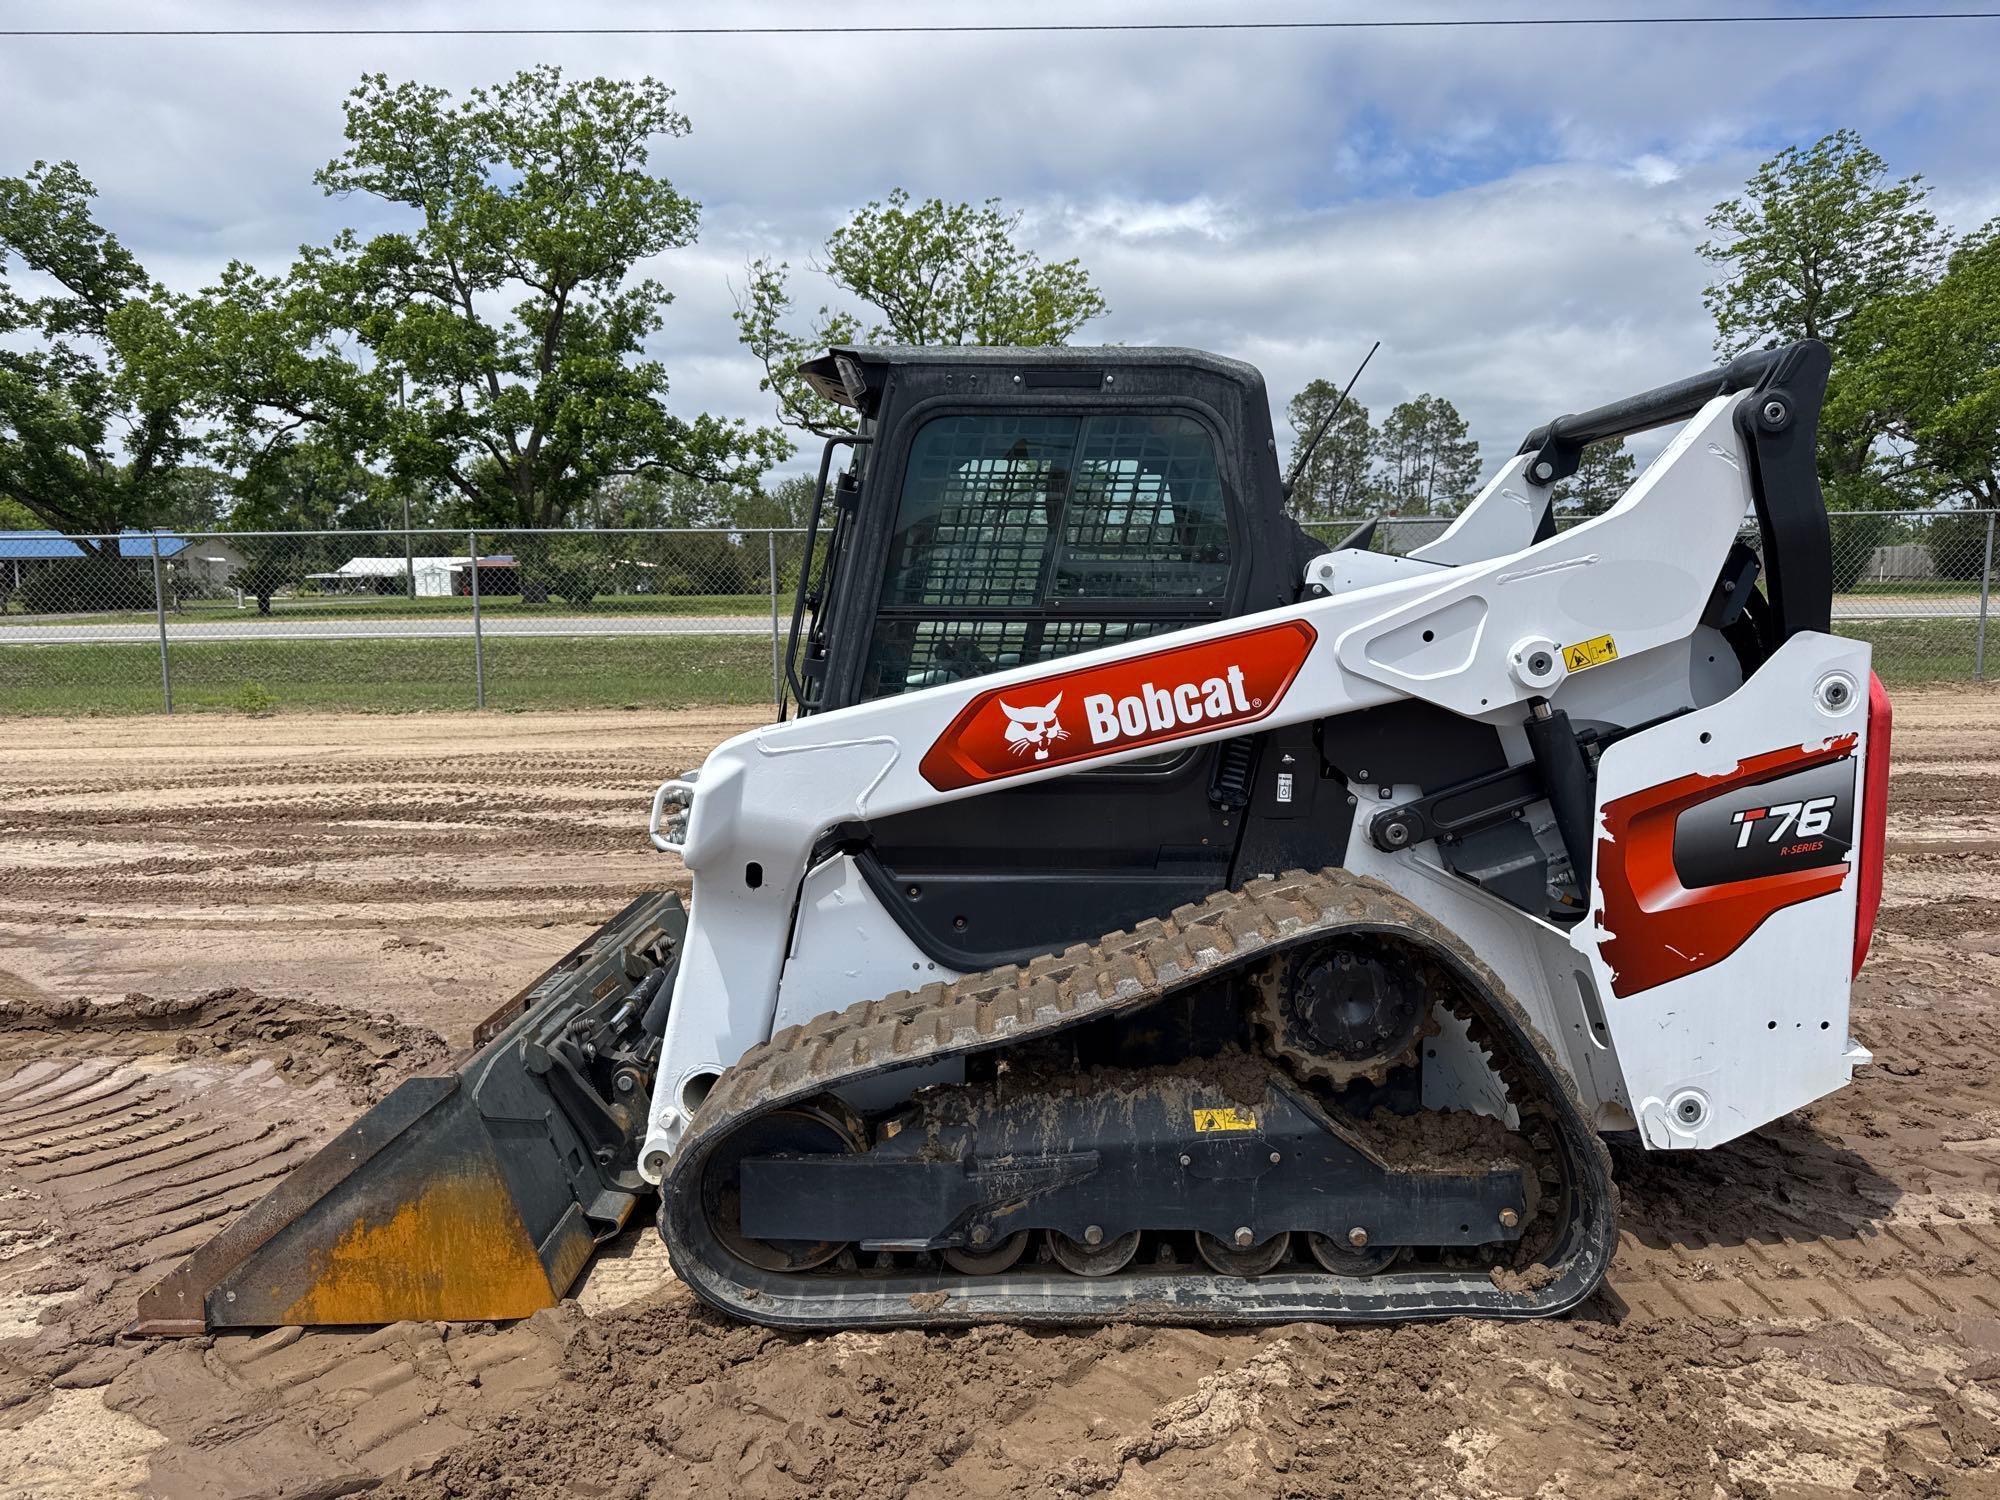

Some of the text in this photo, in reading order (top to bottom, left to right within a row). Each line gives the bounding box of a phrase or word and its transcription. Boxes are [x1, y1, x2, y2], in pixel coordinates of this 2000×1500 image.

[1084, 665, 1251, 744] Bobcat
[1732, 796, 1836, 848] T76
[1780, 840, 1824, 856] R-SERIES
